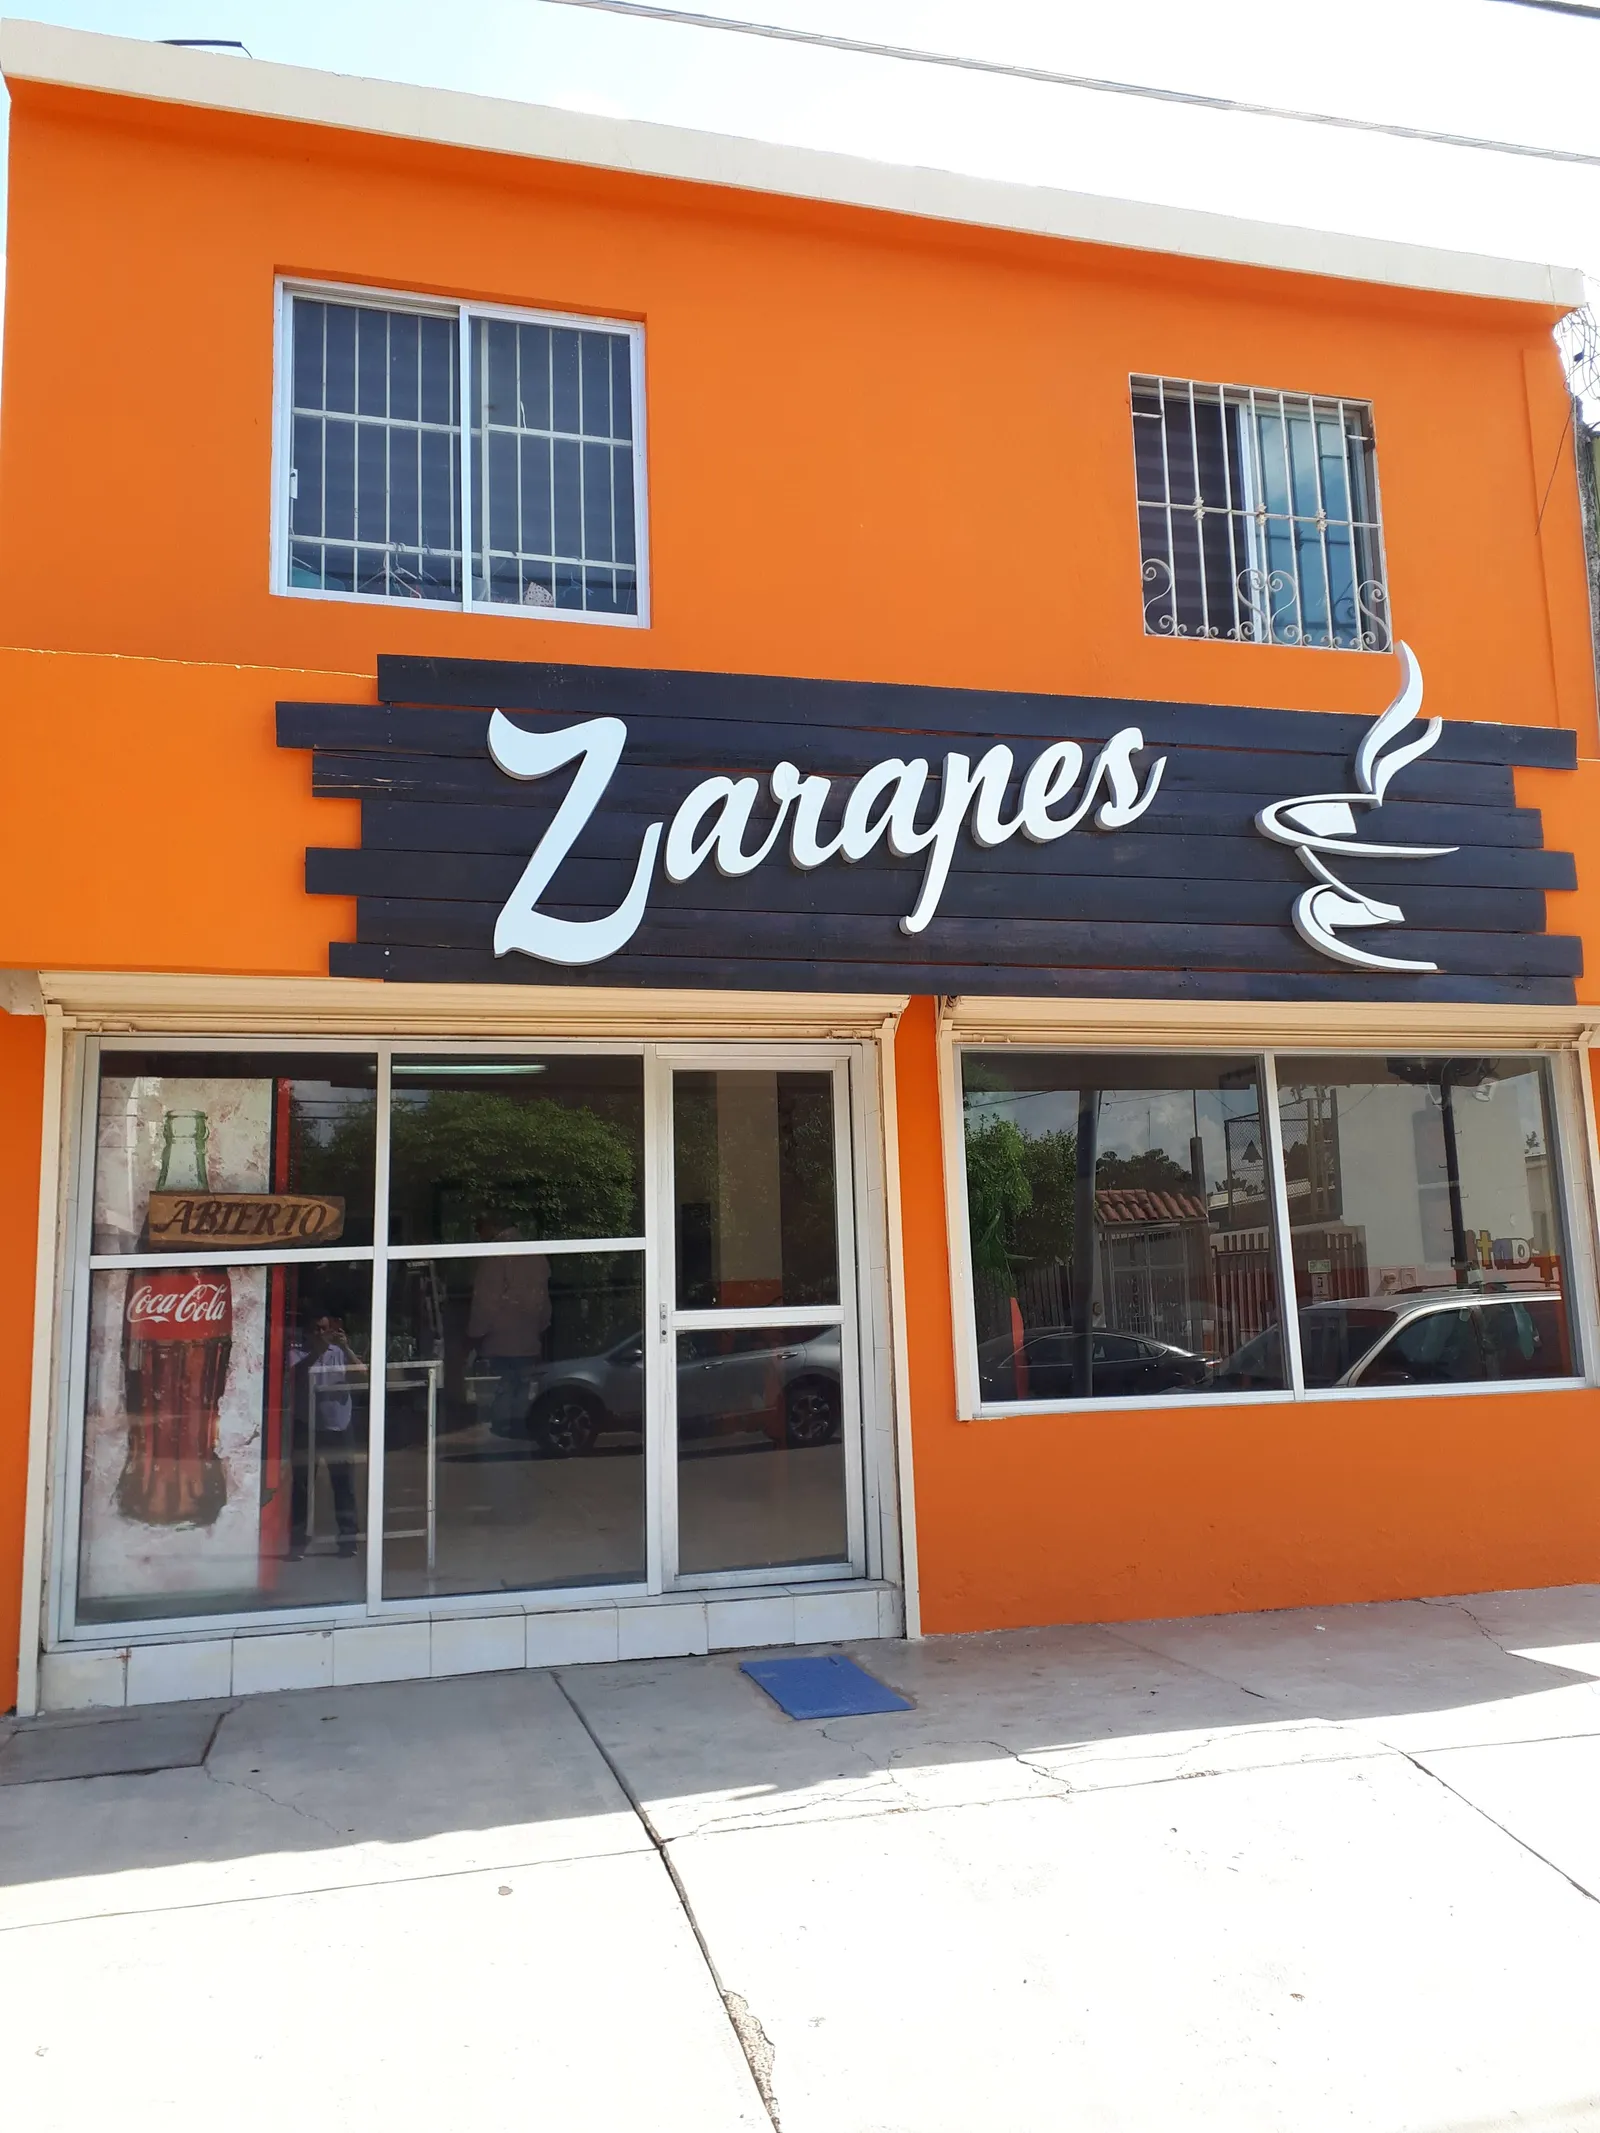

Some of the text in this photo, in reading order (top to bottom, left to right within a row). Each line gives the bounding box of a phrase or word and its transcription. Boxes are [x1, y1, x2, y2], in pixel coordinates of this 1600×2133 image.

[487, 708, 1167, 966] Zarapes
[152, 1199, 328, 1238] ABIERTO
[126, 1283, 229, 1324] Coca-Cola
